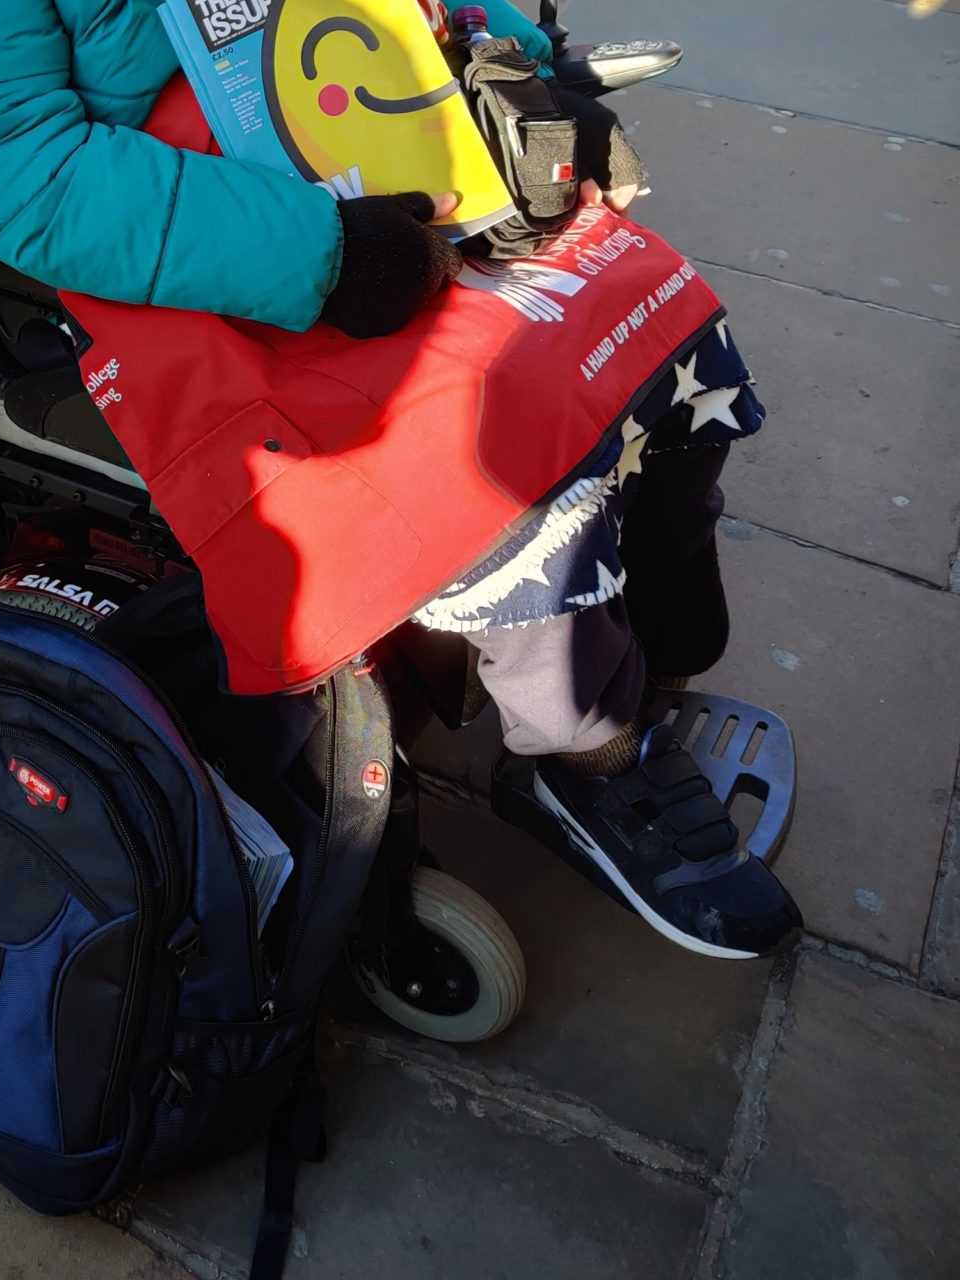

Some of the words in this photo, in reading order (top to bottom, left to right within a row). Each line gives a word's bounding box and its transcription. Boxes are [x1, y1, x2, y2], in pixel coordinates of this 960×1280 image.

[583, 228, 646, 266] Nursing
[575, 253, 602, 275] of
[647, 294, 659, 313] A
[654, 273, 685, 305] HAND
[626, 301, 649, 331] NOT
[611, 321, 630, 345] UP
[585, 336, 616, 373] HAND
[579, 363, 594, 381] A
[17, 574, 94, 607] SALSA
